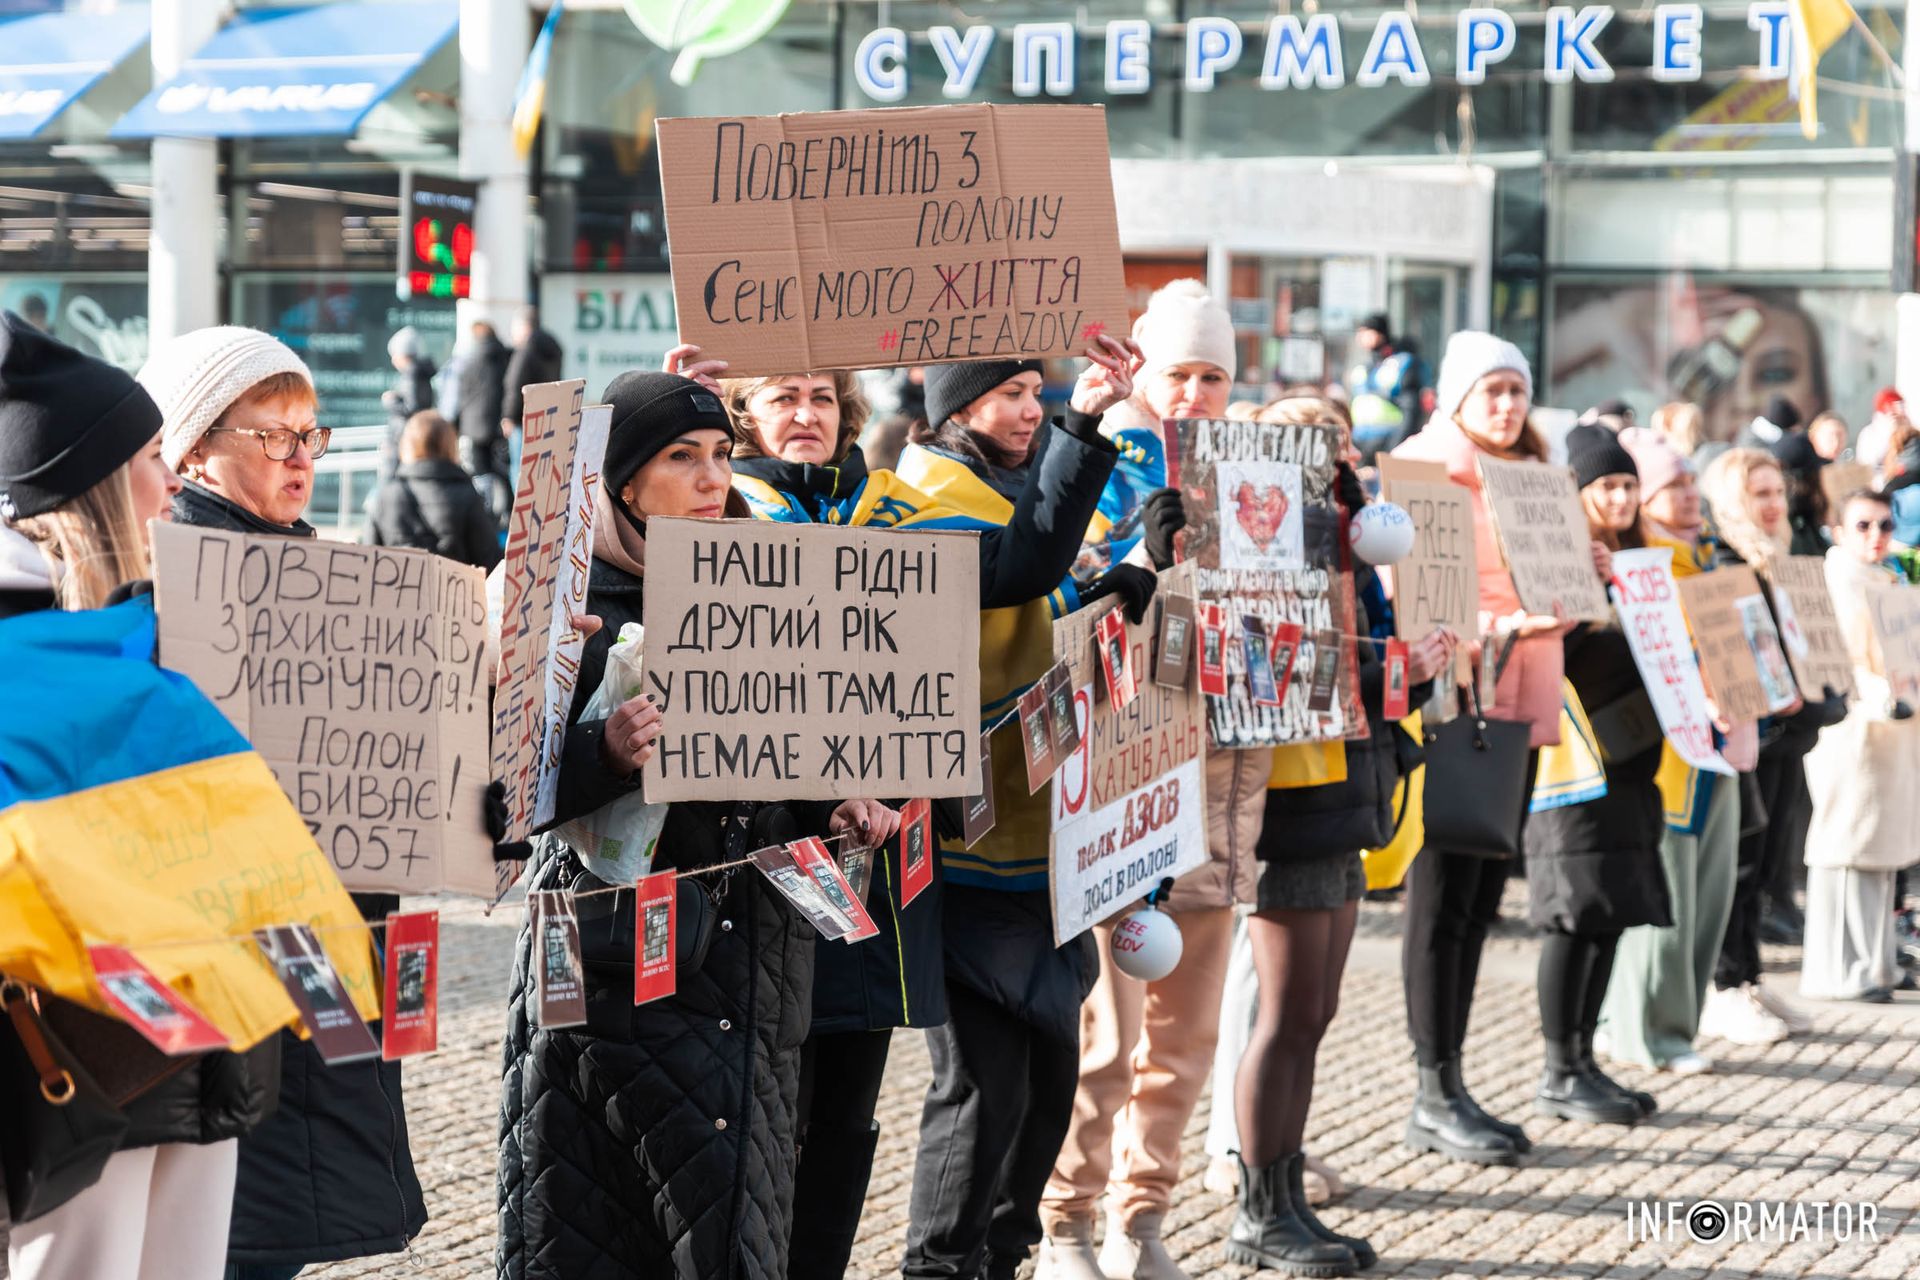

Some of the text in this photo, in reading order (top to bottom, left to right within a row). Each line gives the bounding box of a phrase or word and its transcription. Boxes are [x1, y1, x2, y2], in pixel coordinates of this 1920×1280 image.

[854, 2, 1792, 101] СУПЕРМАРКЕТ
[915, 195, 1063, 248] ПОЛОНУ
[813, 266, 915, 321] МОГО
[929, 255, 1082, 313] ЖИТТЯ
[536, 405, 559, 480] НЕ
[1195, 419, 1328, 467] АЗОВСТАЛЬ
[497, 410, 545, 690] ВМИРАТИ
[1408, 499, 1461, 560] FREE
[518, 500, 542, 639] ДАЙ
[693, 537, 937, 599] НАШІ РІДНІ
[667, 594, 899, 655] ДРУГИЙ РІК
[297, 716, 426, 767] ПОЛОН
[820, 729, 967, 781] ЖИТТЯ
[1092, 714, 1198, 806] КАТУВАНЬ
[1119, 778, 1180, 849] АЗОВ
[1114, 934, 1146, 953] ZOV
